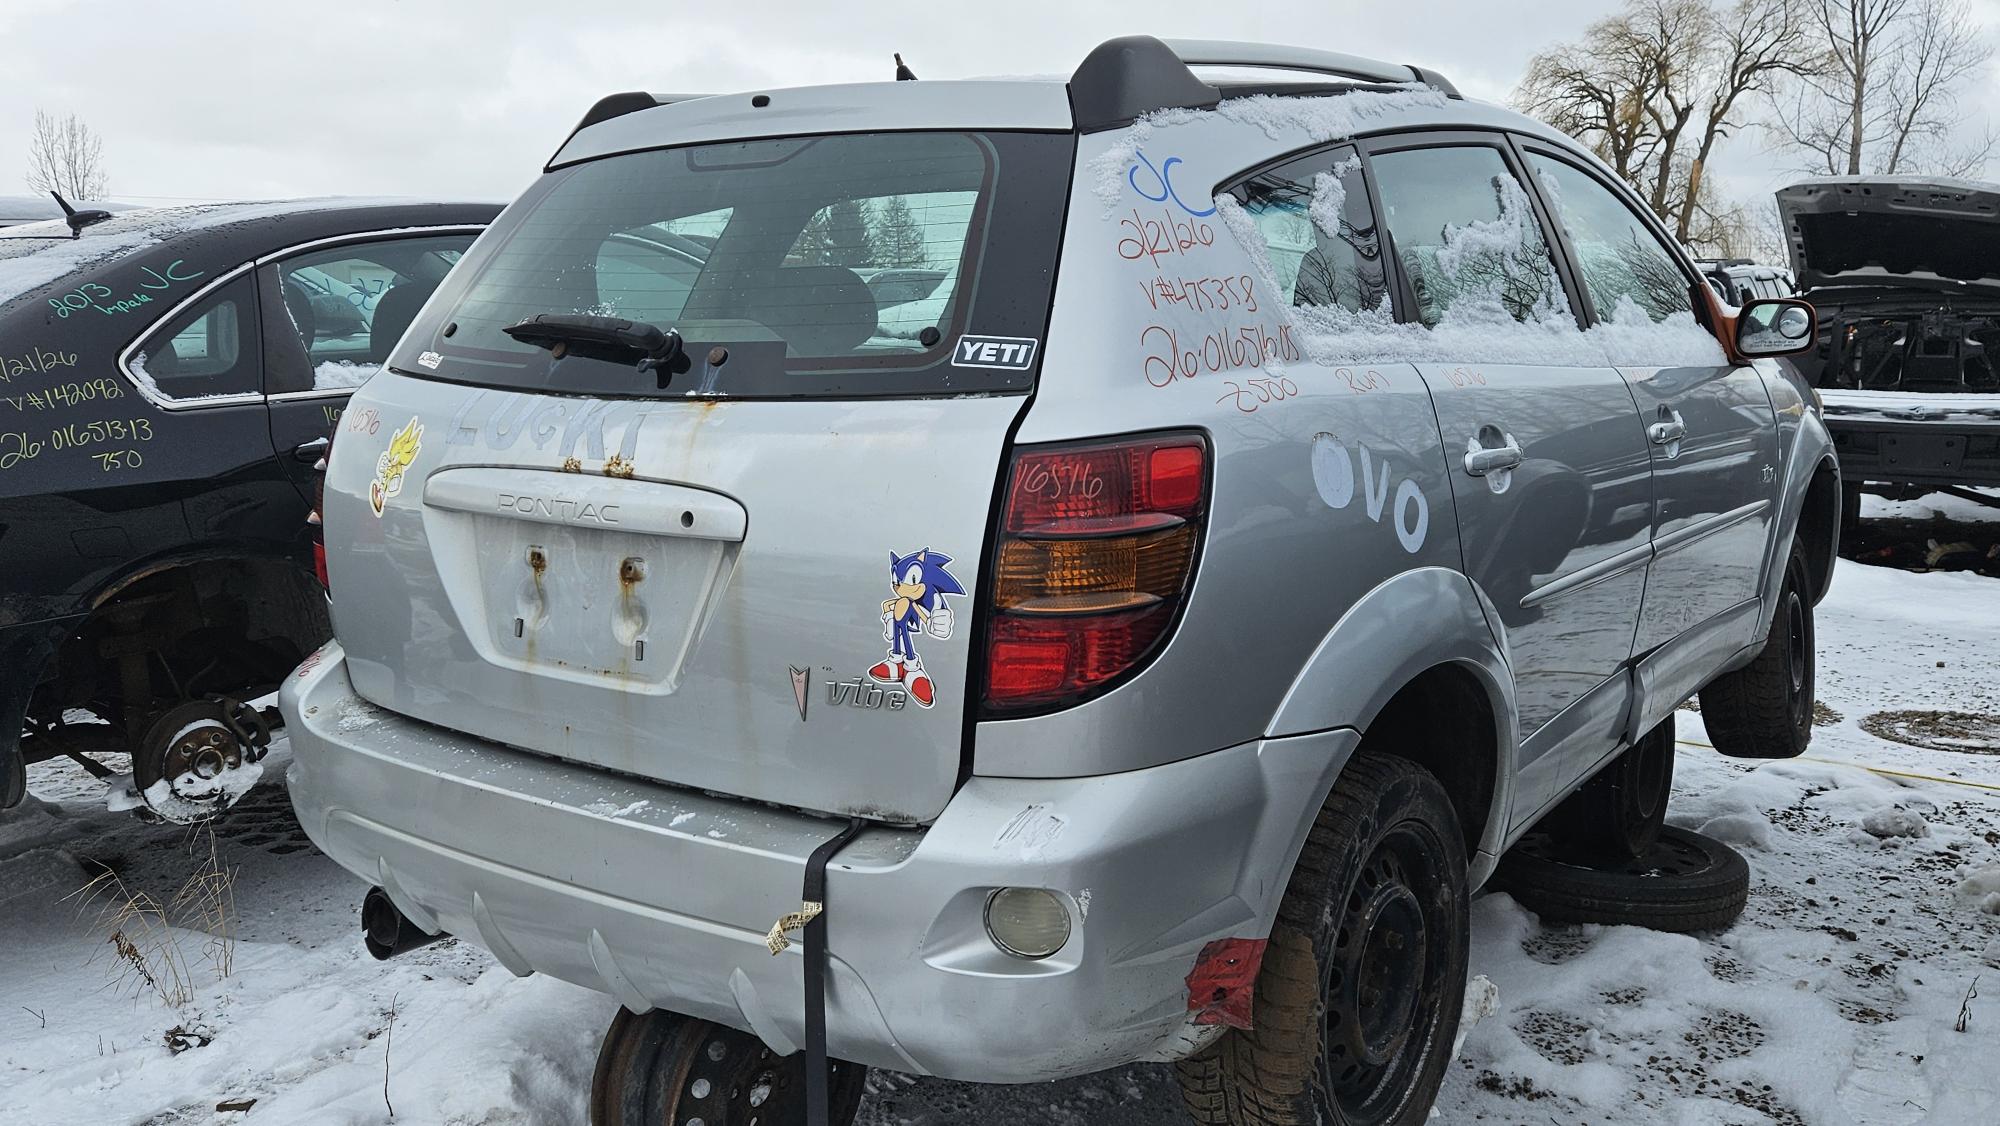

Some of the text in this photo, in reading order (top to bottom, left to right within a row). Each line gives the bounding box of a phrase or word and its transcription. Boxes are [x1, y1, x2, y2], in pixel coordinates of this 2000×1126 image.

[1118, 209, 1214, 269] 2/21/26
[48, 283, 112, 318] 2013
[0, 346, 78, 383] /21/26
[963, 341, 1031, 364] YETI
[91, 449, 142, 472] 750
[496, 493, 620, 525] PONTIAC
